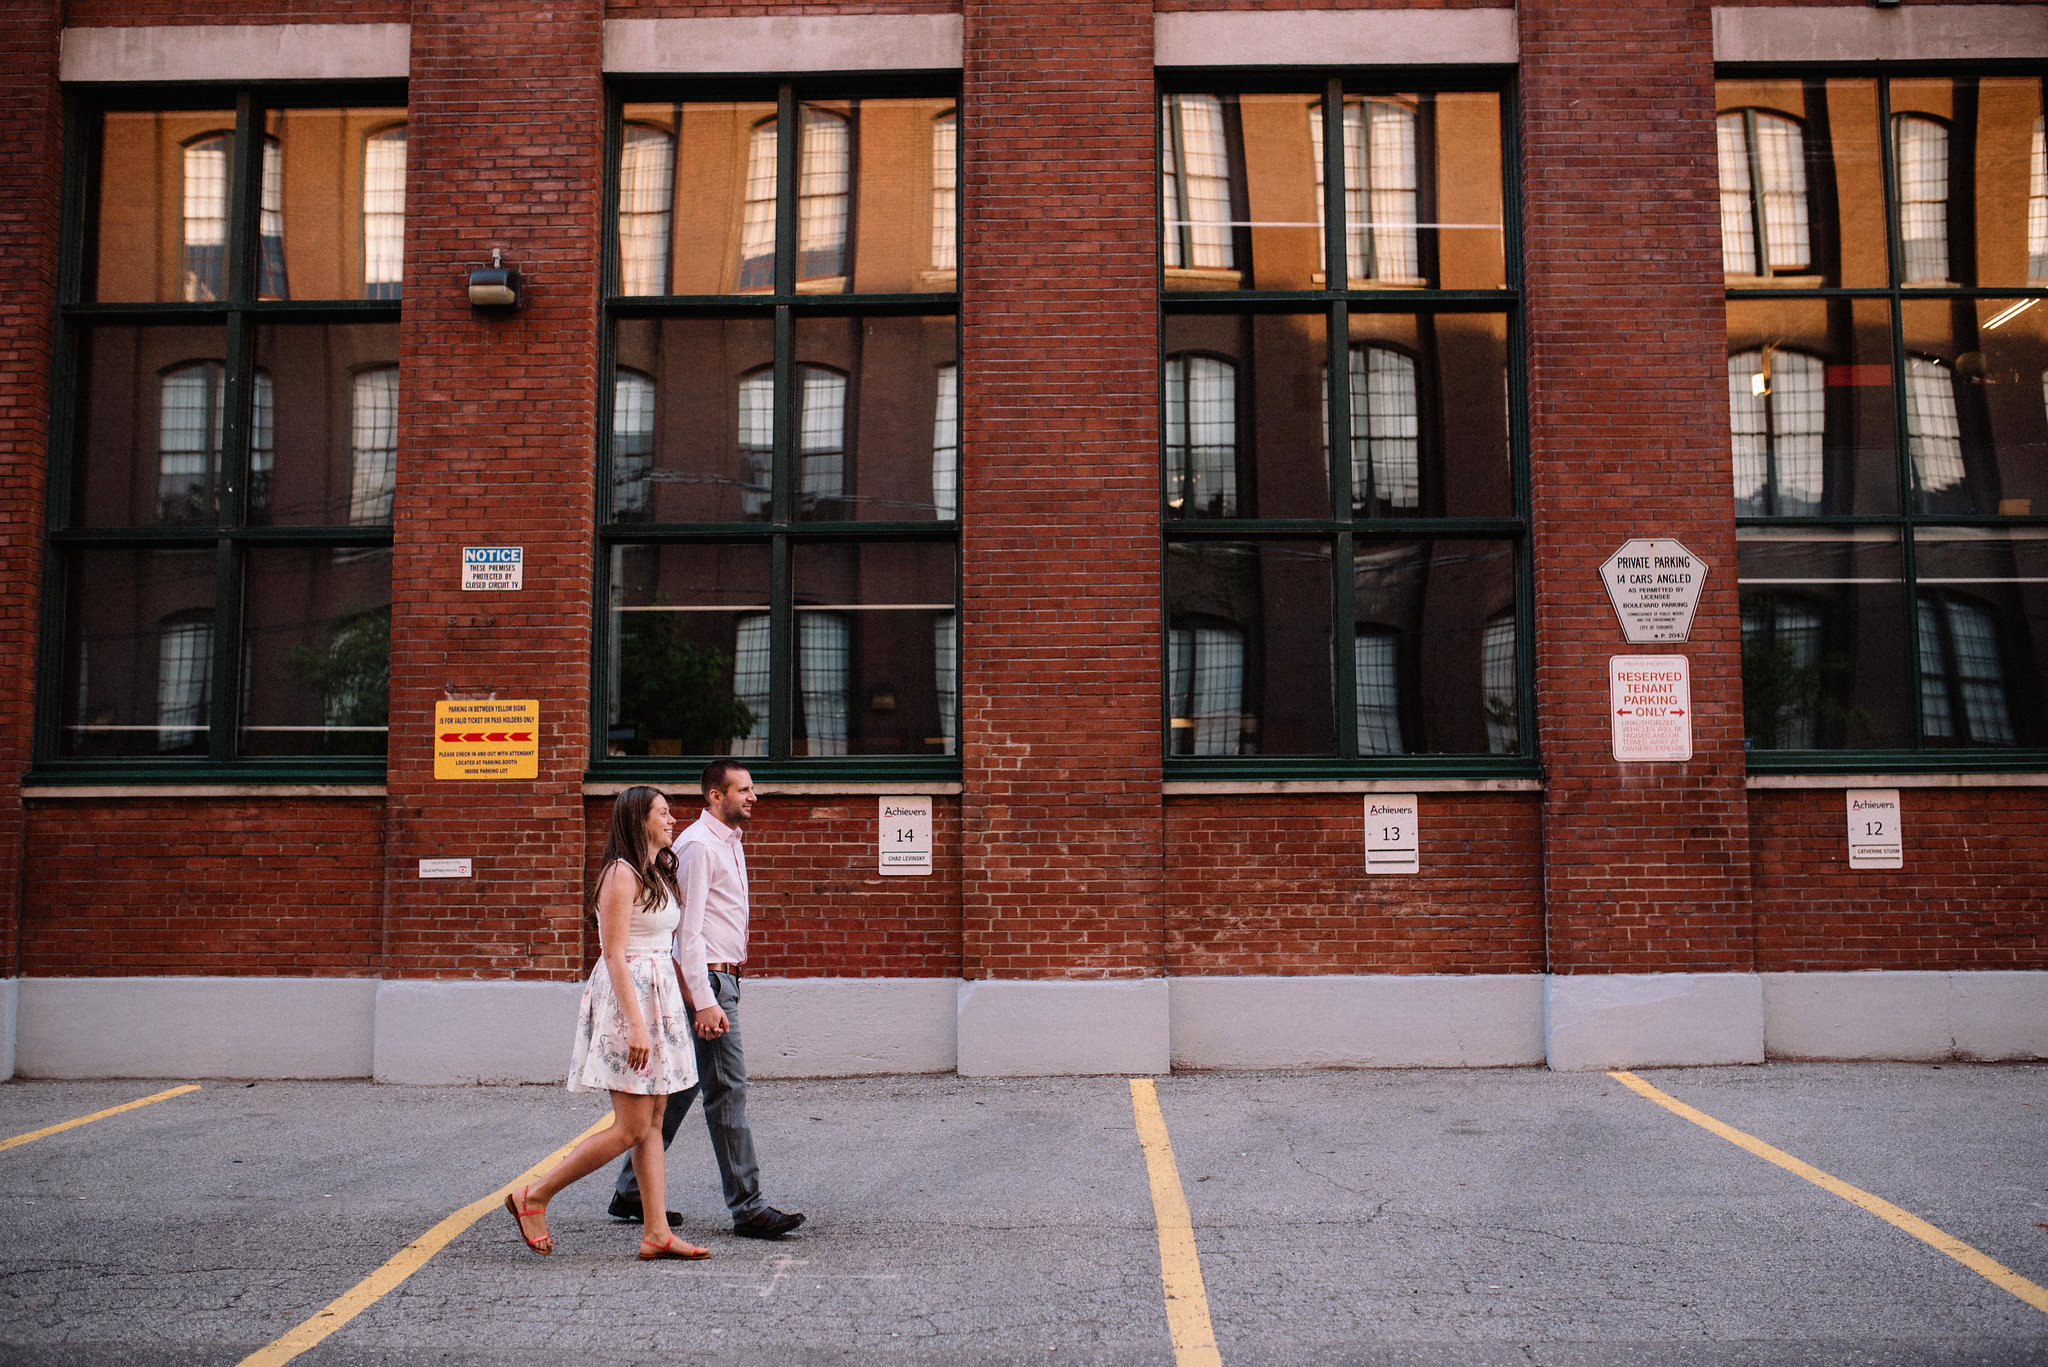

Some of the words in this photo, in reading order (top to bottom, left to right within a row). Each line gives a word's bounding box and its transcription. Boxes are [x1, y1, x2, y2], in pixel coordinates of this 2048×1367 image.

[466, 550, 520, 561] NOTICE
[1617, 557, 1650, 568] PRIVATE
[1654, 556, 1690, 568] PARKING
[1617, 575, 1625, 584] 14
[1630, 575, 1652, 584] CARS
[1657, 574, 1691, 583] ANGLED
[1617, 672, 1682, 681] RESERVED
[1627, 684, 1674, 693] TENANT
[1624, 696, 1677, 705] PARKING
[1636, 708, 1667, 716] ONLY
[1853, 800, 1894, 809] Achievers
[885, 807, 926, 816] Achievers
[1370, 805, 1412, 814] Achievers
[1866, 822, 1883, 835] 12
[896, 829, 914, 842] 14
[1383, 827, 1400, 841] 13
